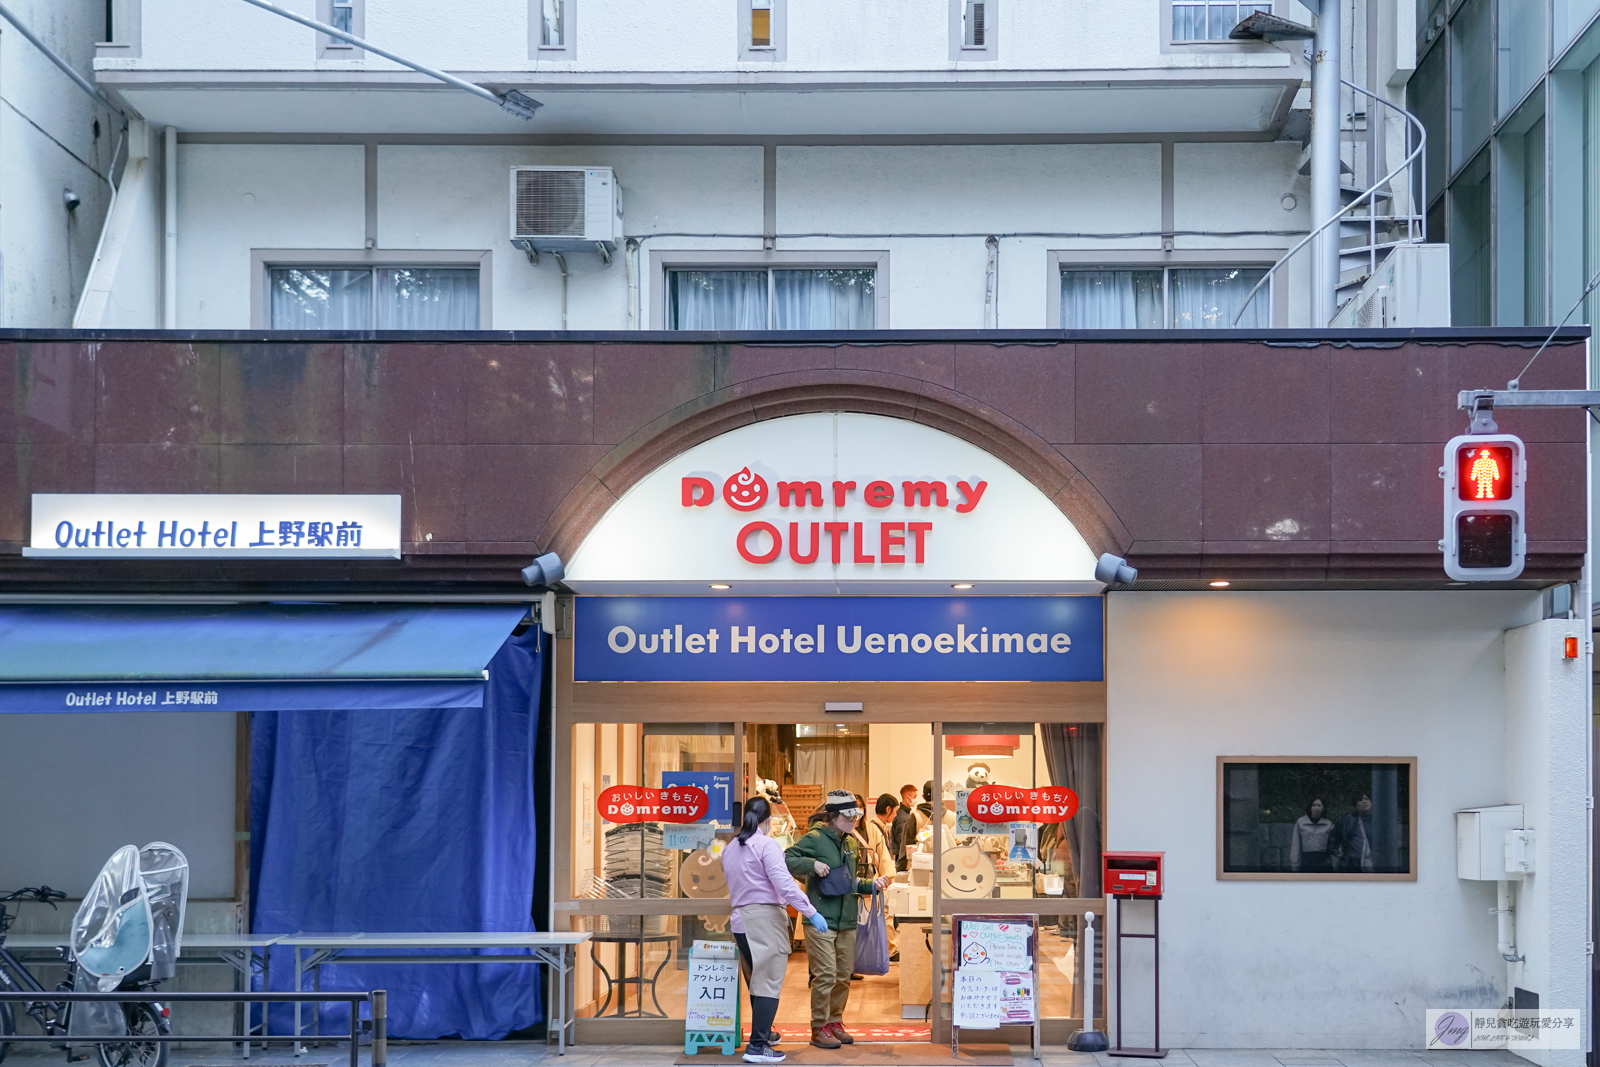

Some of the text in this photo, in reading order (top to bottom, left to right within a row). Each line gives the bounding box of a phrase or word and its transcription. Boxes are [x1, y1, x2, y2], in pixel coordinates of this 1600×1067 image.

[55, 521, 362, 548] Outlet Hotel 上野駅前
[737, 521, 932, 565] OUTLET
[608, 624, 1071, 655] Outlet Hotel Uenoekimae
[66, 691, 218, 706] Outlet Hotel 上野駅前
[611, 791, 655, 802] おいしい
[981, 791, 1024, 802] おいしい
[698, 964, 733, 972] ドンレミー
[693, 974, 736, 983] アウトレット
[960, 975, 982, 983] 本日の
[699, 986, 725, 1000] 入口
